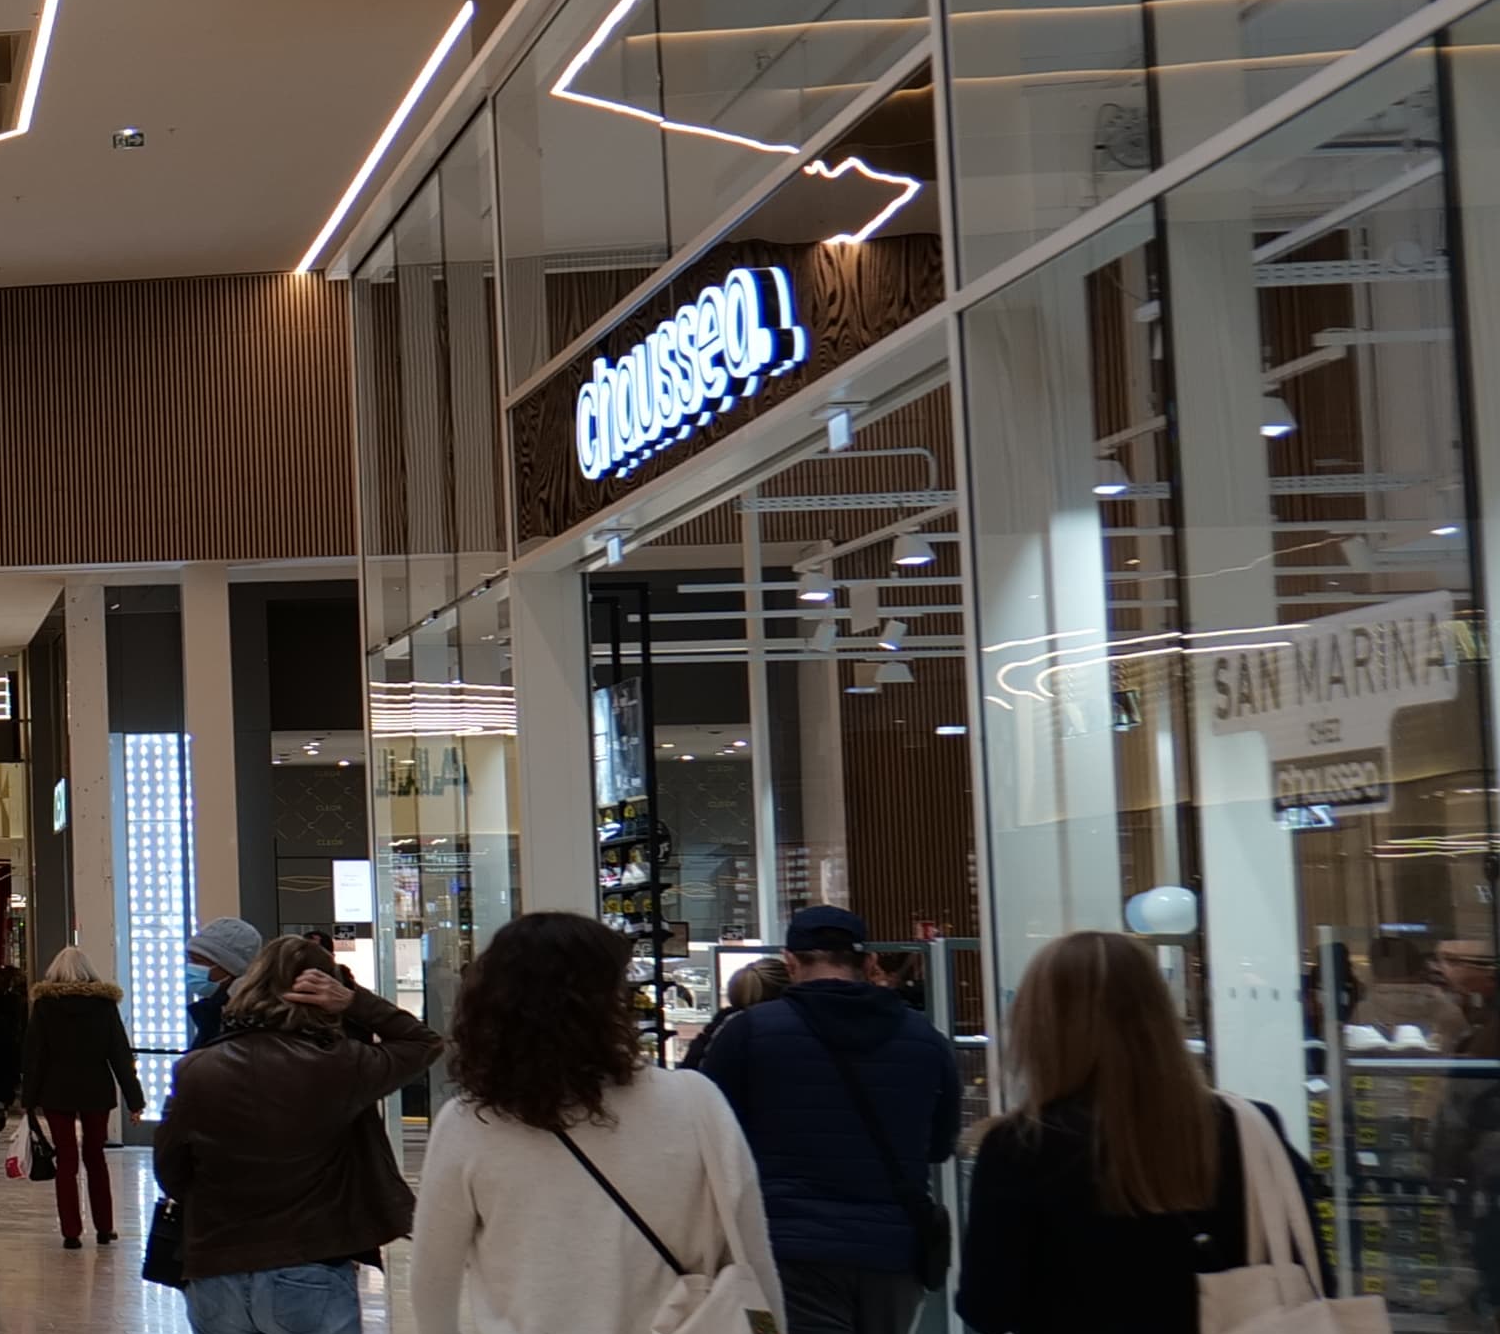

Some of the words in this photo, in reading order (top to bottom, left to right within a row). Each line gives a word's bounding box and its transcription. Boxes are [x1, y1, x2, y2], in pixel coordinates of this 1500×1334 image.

[576, 267, 772, 479] chaussea
[1213, 650, 1281, 721] SAN
[1293, 613, 1451, 704] MARINA
